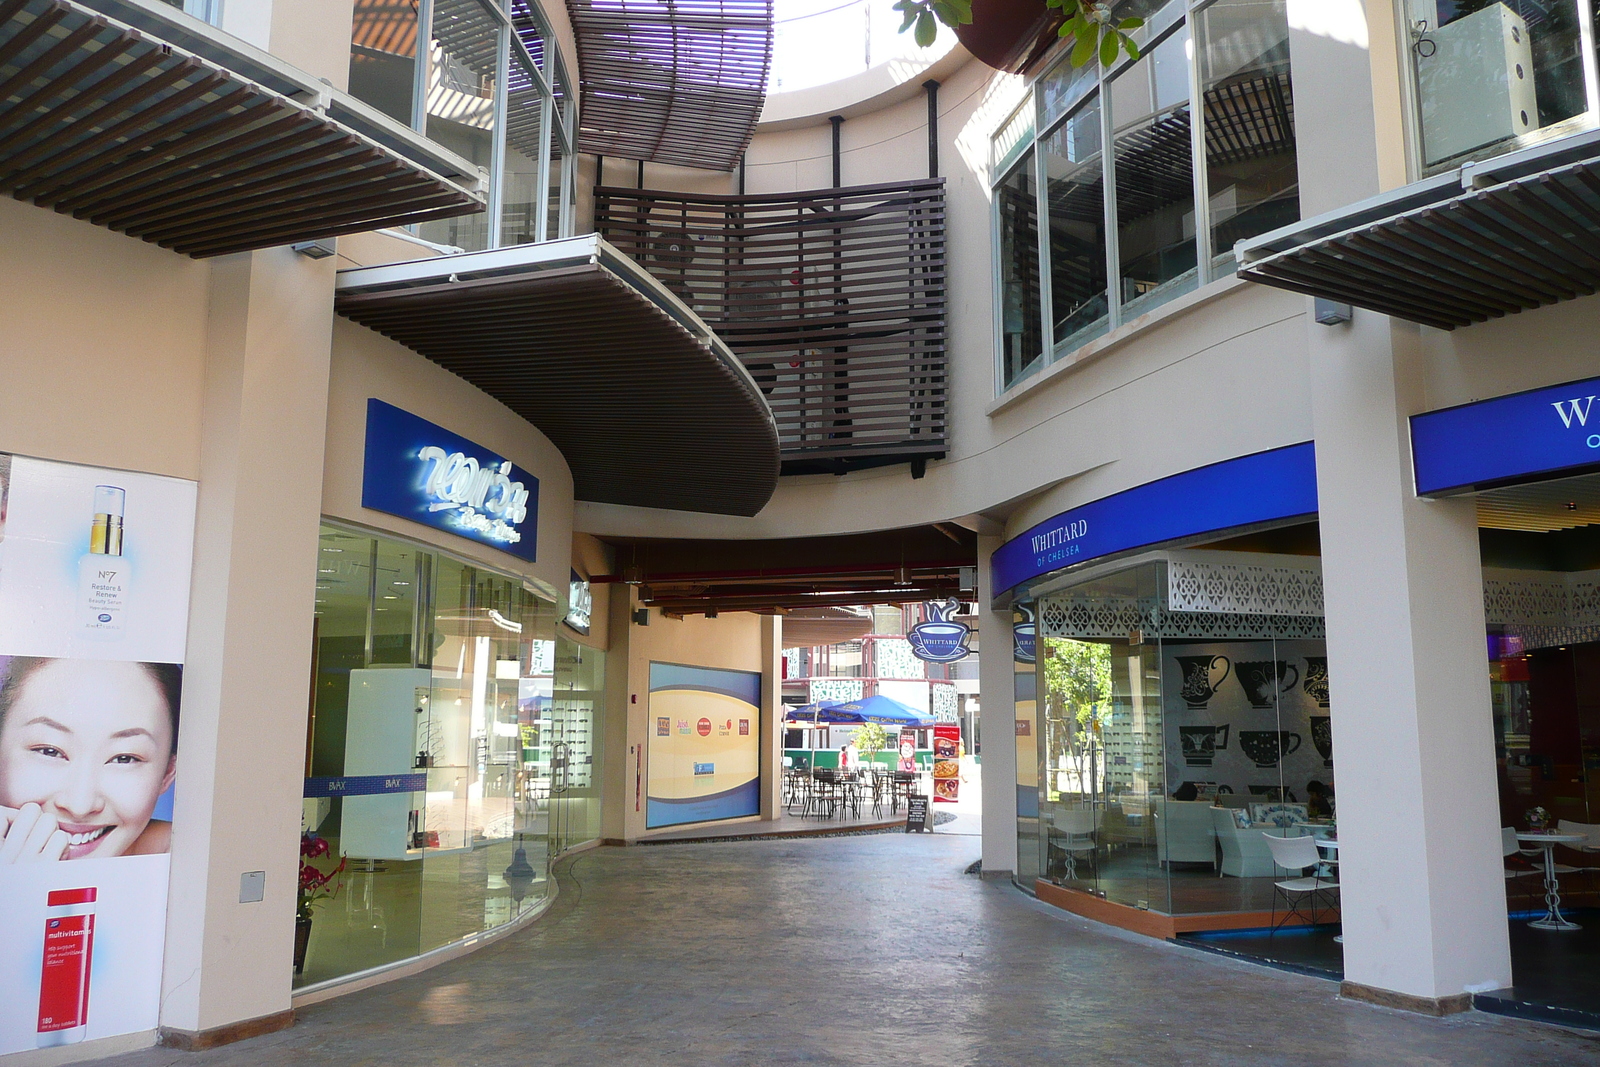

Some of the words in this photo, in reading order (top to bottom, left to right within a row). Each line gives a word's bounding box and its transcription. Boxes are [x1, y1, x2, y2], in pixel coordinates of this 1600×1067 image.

[1031, 519, 1088, 555] WHITTARD
[1037, 556, 1045, 567] OF
[1048, 544, 1080, 563] CHELSEA
[91, 583, 117, 591] Restore
[48, 929, 92, 939] multivitams
